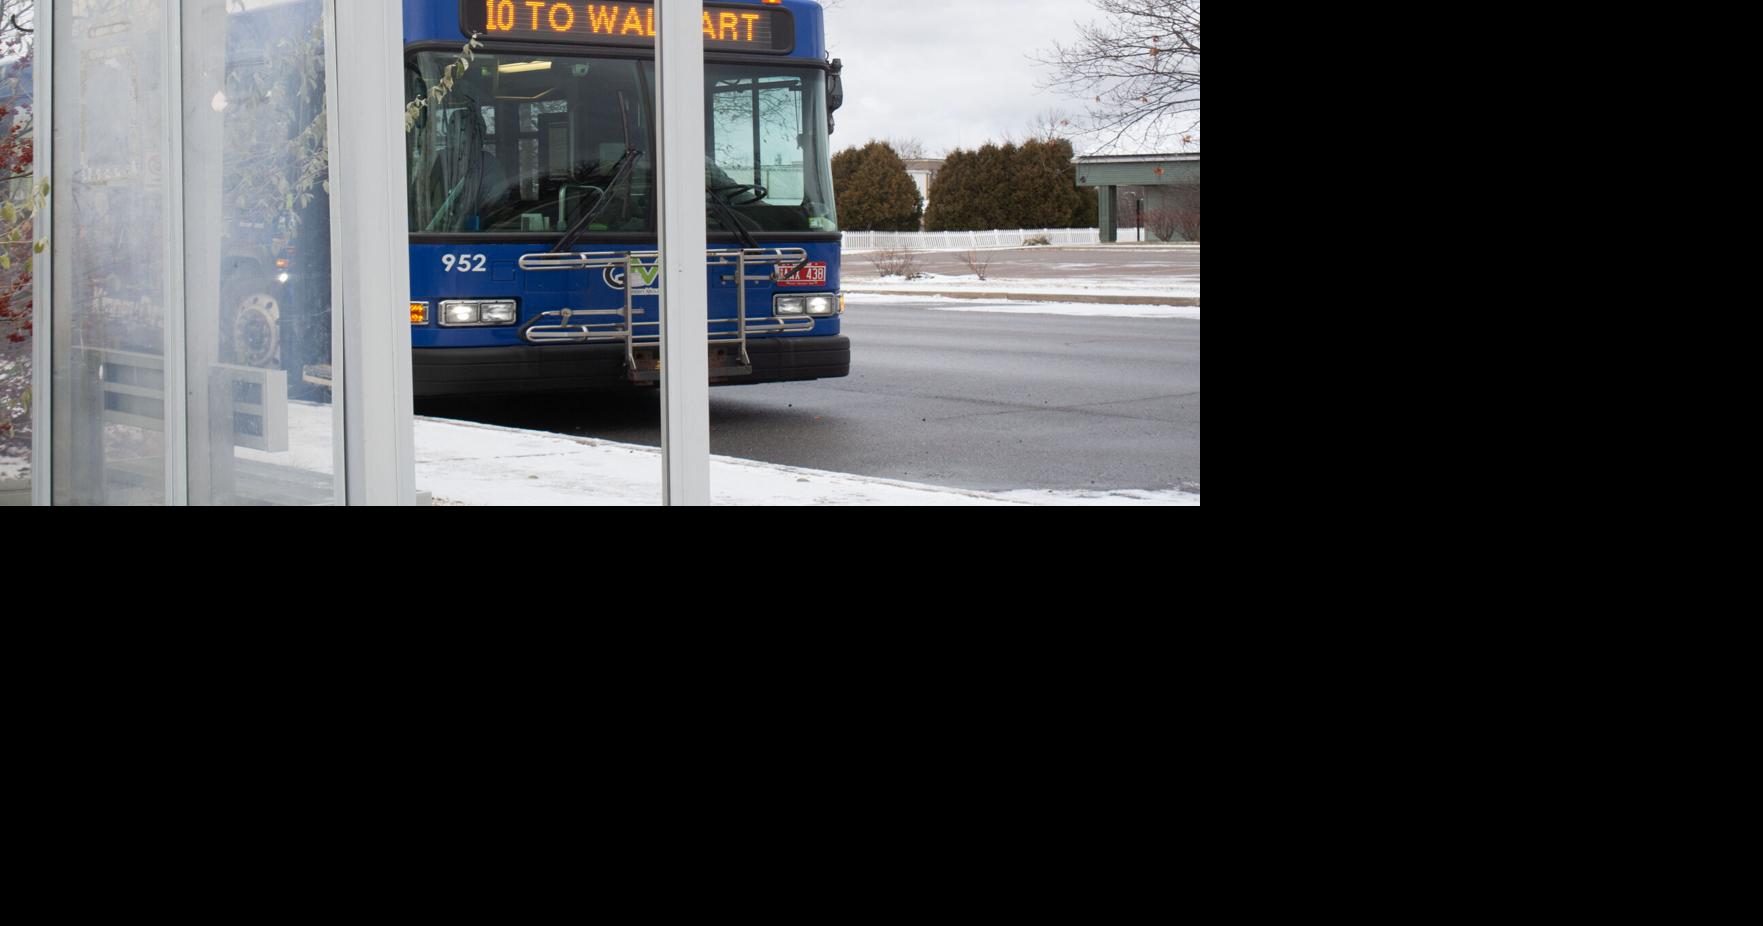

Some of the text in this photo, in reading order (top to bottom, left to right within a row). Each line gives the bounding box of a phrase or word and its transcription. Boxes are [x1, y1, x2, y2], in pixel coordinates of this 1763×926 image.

[486, 0, 759, 41] 10 TO WALART
[441, 253, 487, 272] 952
[806, 267, 823, 280] 438
